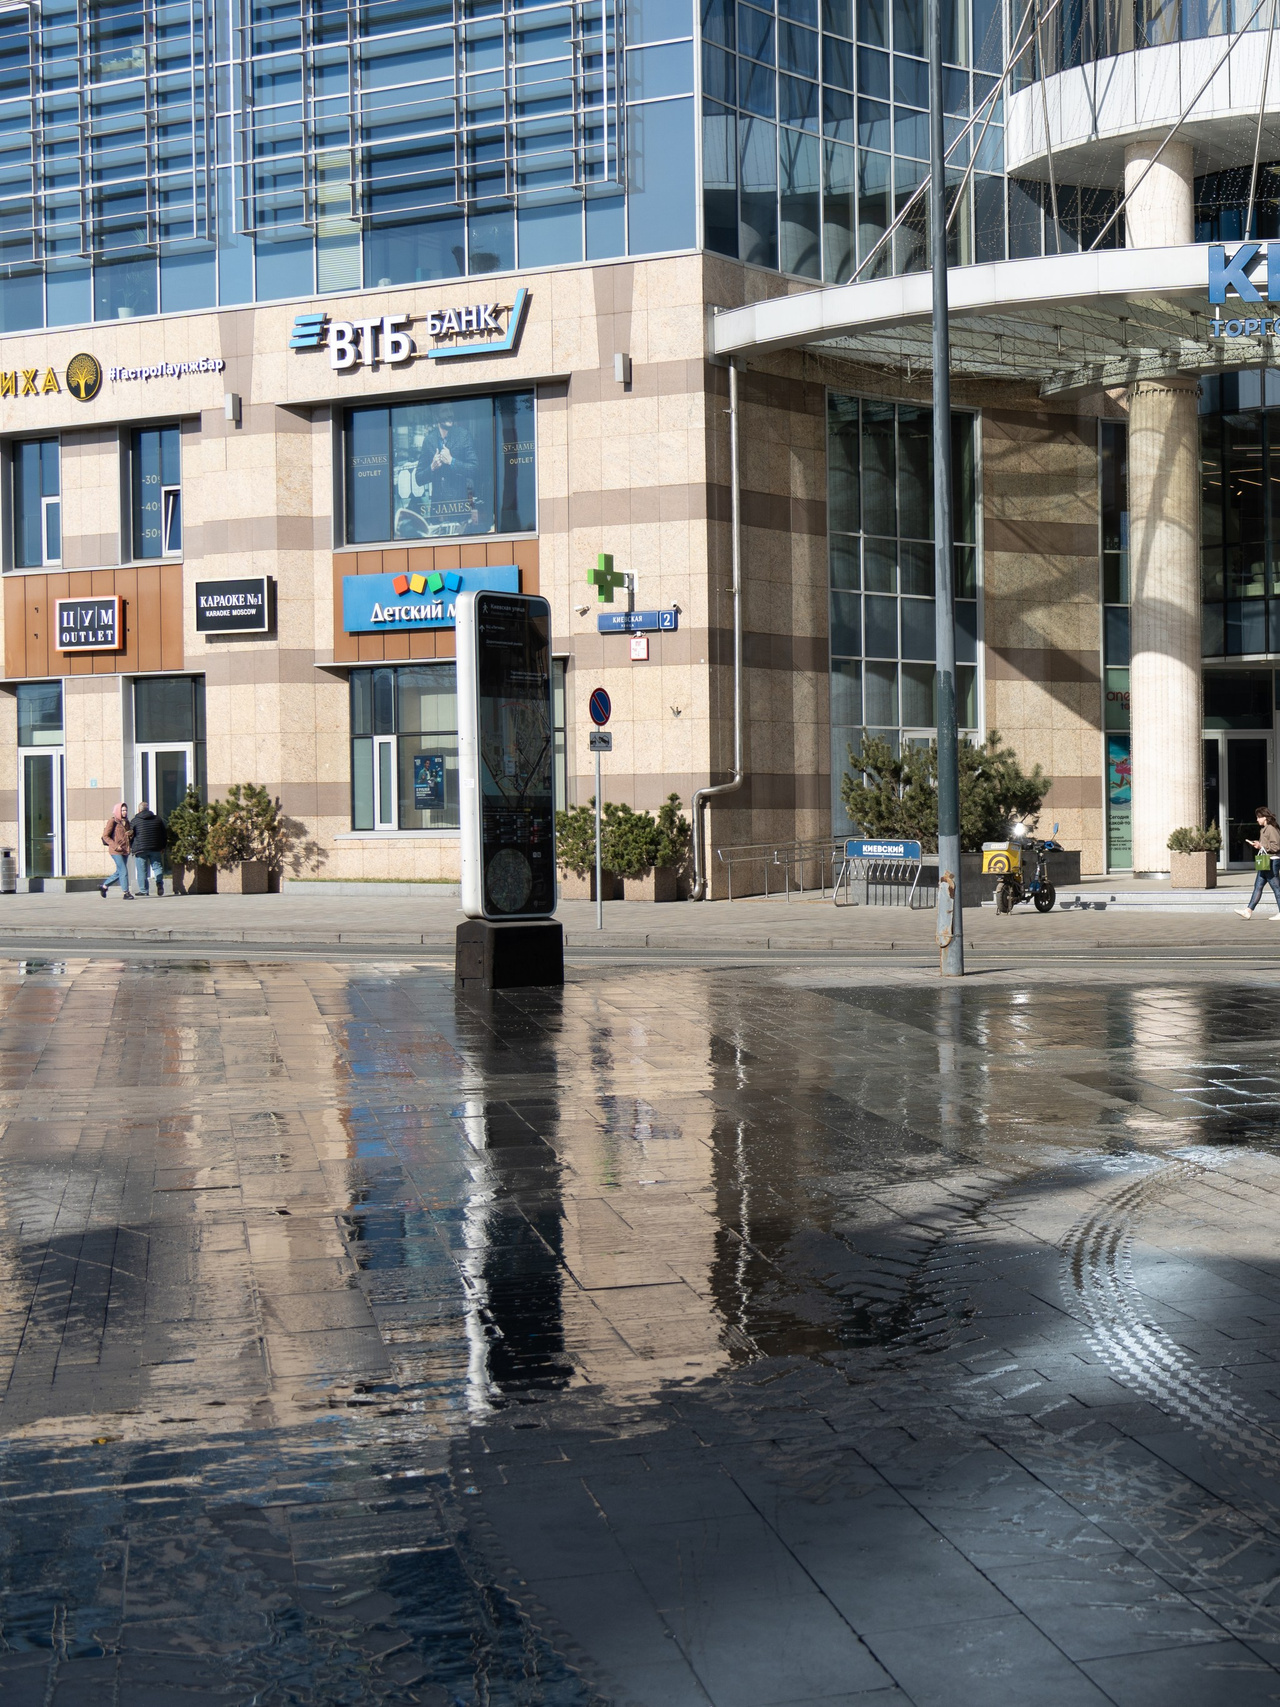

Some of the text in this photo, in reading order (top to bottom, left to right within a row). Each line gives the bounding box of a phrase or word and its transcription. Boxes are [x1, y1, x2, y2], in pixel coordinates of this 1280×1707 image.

[329, 302, 500, 370] ВТБ БАНК
[503, 443, 535, 452] ST-JAME
[509, 456, 533, 465] OUTLET
[200, 593, 263, 608] КАРАОКЕ №1
[206, 608, 257, 618] KARAOKE MOSCOW
[370, 599, 443, 623] Детский
[612, 613, 671, 626] КИЕВСКАЯ 2
[62, 629, 114, 643] OUTLET
[1106, 691, 1130, 702] ane
[862, 844, 904, 854] КИЕВСКИЙ
